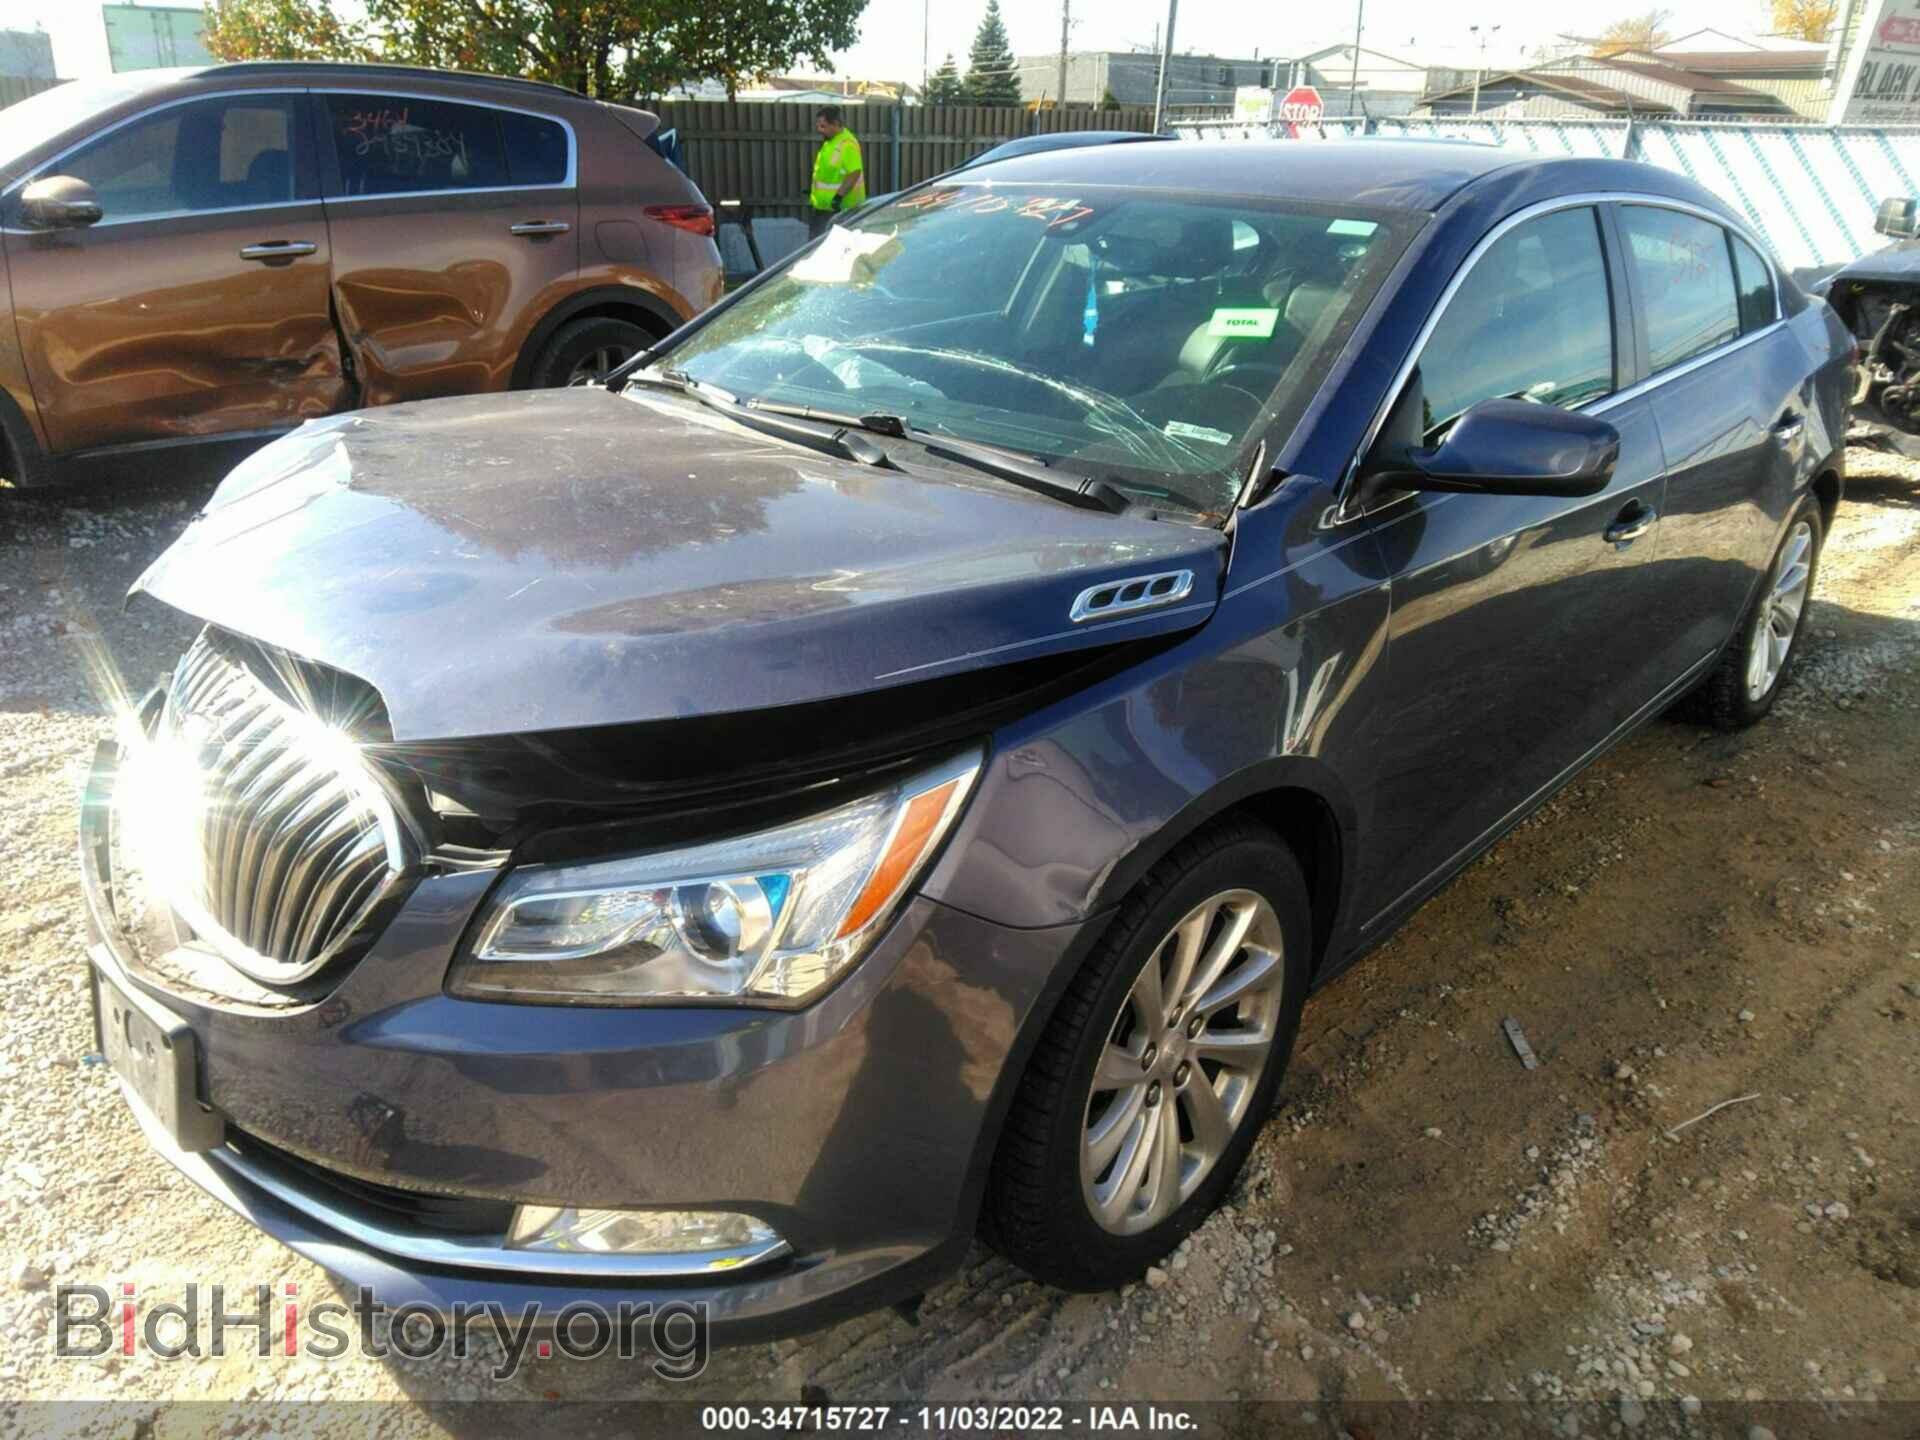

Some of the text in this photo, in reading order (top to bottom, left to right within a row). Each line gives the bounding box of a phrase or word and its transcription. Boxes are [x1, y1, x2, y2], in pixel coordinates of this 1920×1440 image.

[1854, 61, 1917, 101] BLACK
[1284, 103, 1319, 121] STOP
[1226, 319, 1259, 327] TOTAL
